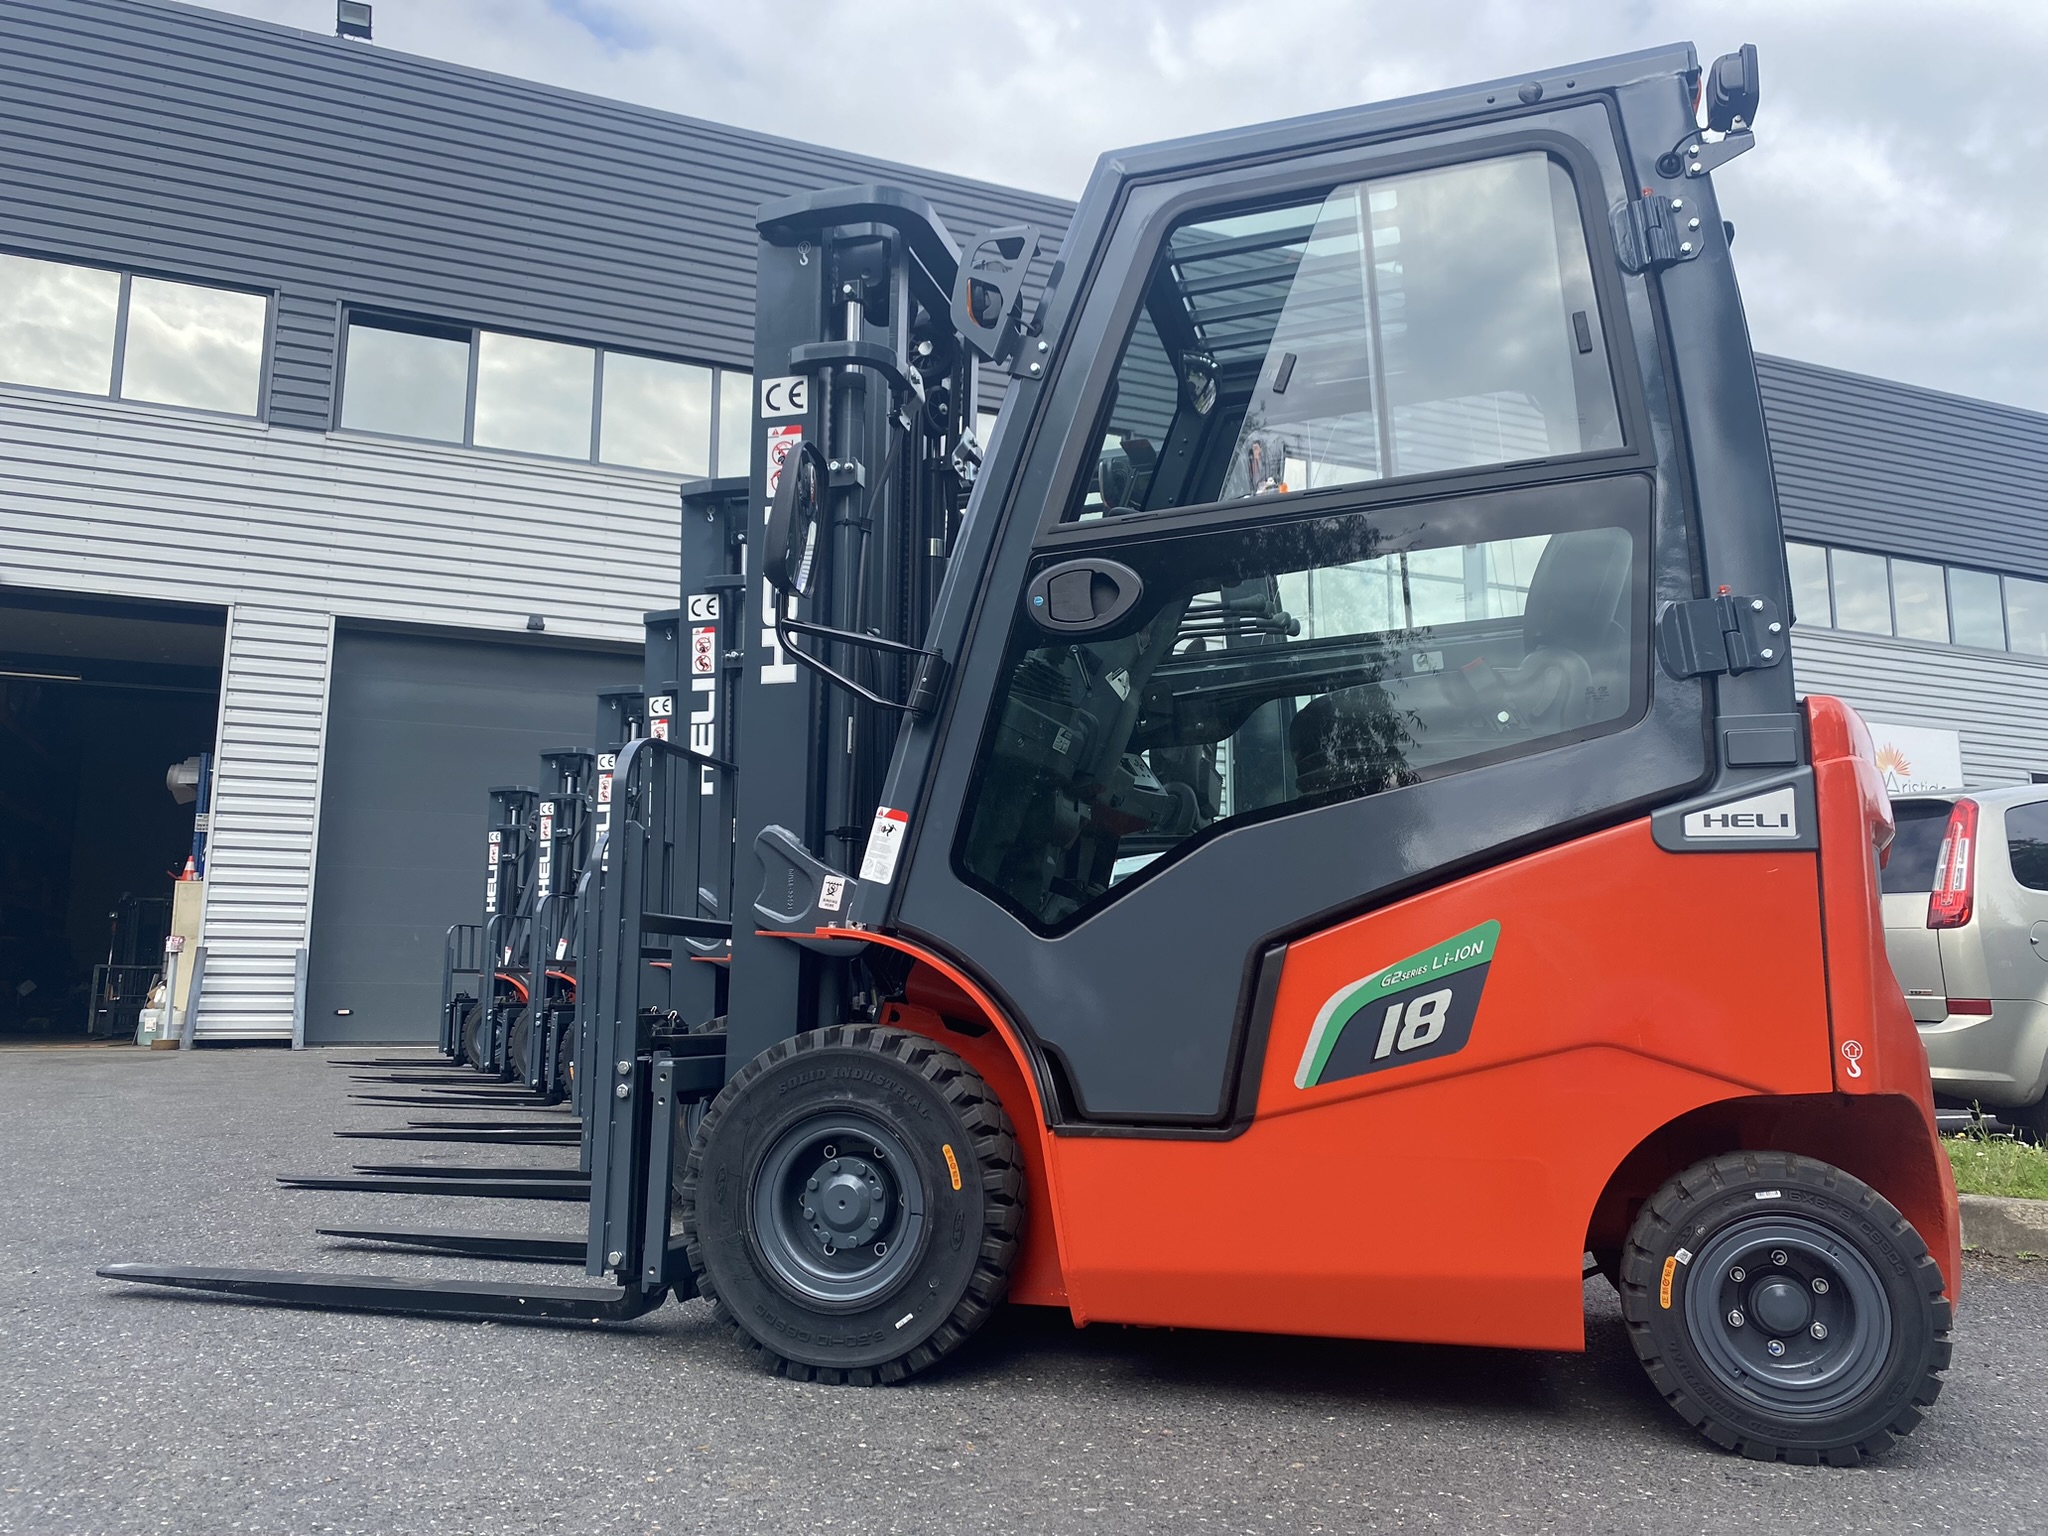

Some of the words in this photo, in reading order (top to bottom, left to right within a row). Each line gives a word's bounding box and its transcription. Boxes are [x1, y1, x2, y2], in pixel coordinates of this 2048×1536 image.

[765, 380, 804, 411] CE
[690, 596, 717, 617] CE
[651, 698, 670, 714] CE
[599, 755, 614, 768] CE
[1703, 813, 1789, 829] HELI
[538, 840, 551, 897] HELI
[485, 864, 499, 913] HELI
[1432, 940, 1485, 970] Li-ION
[1374, 988, 1453, 1060] 18
